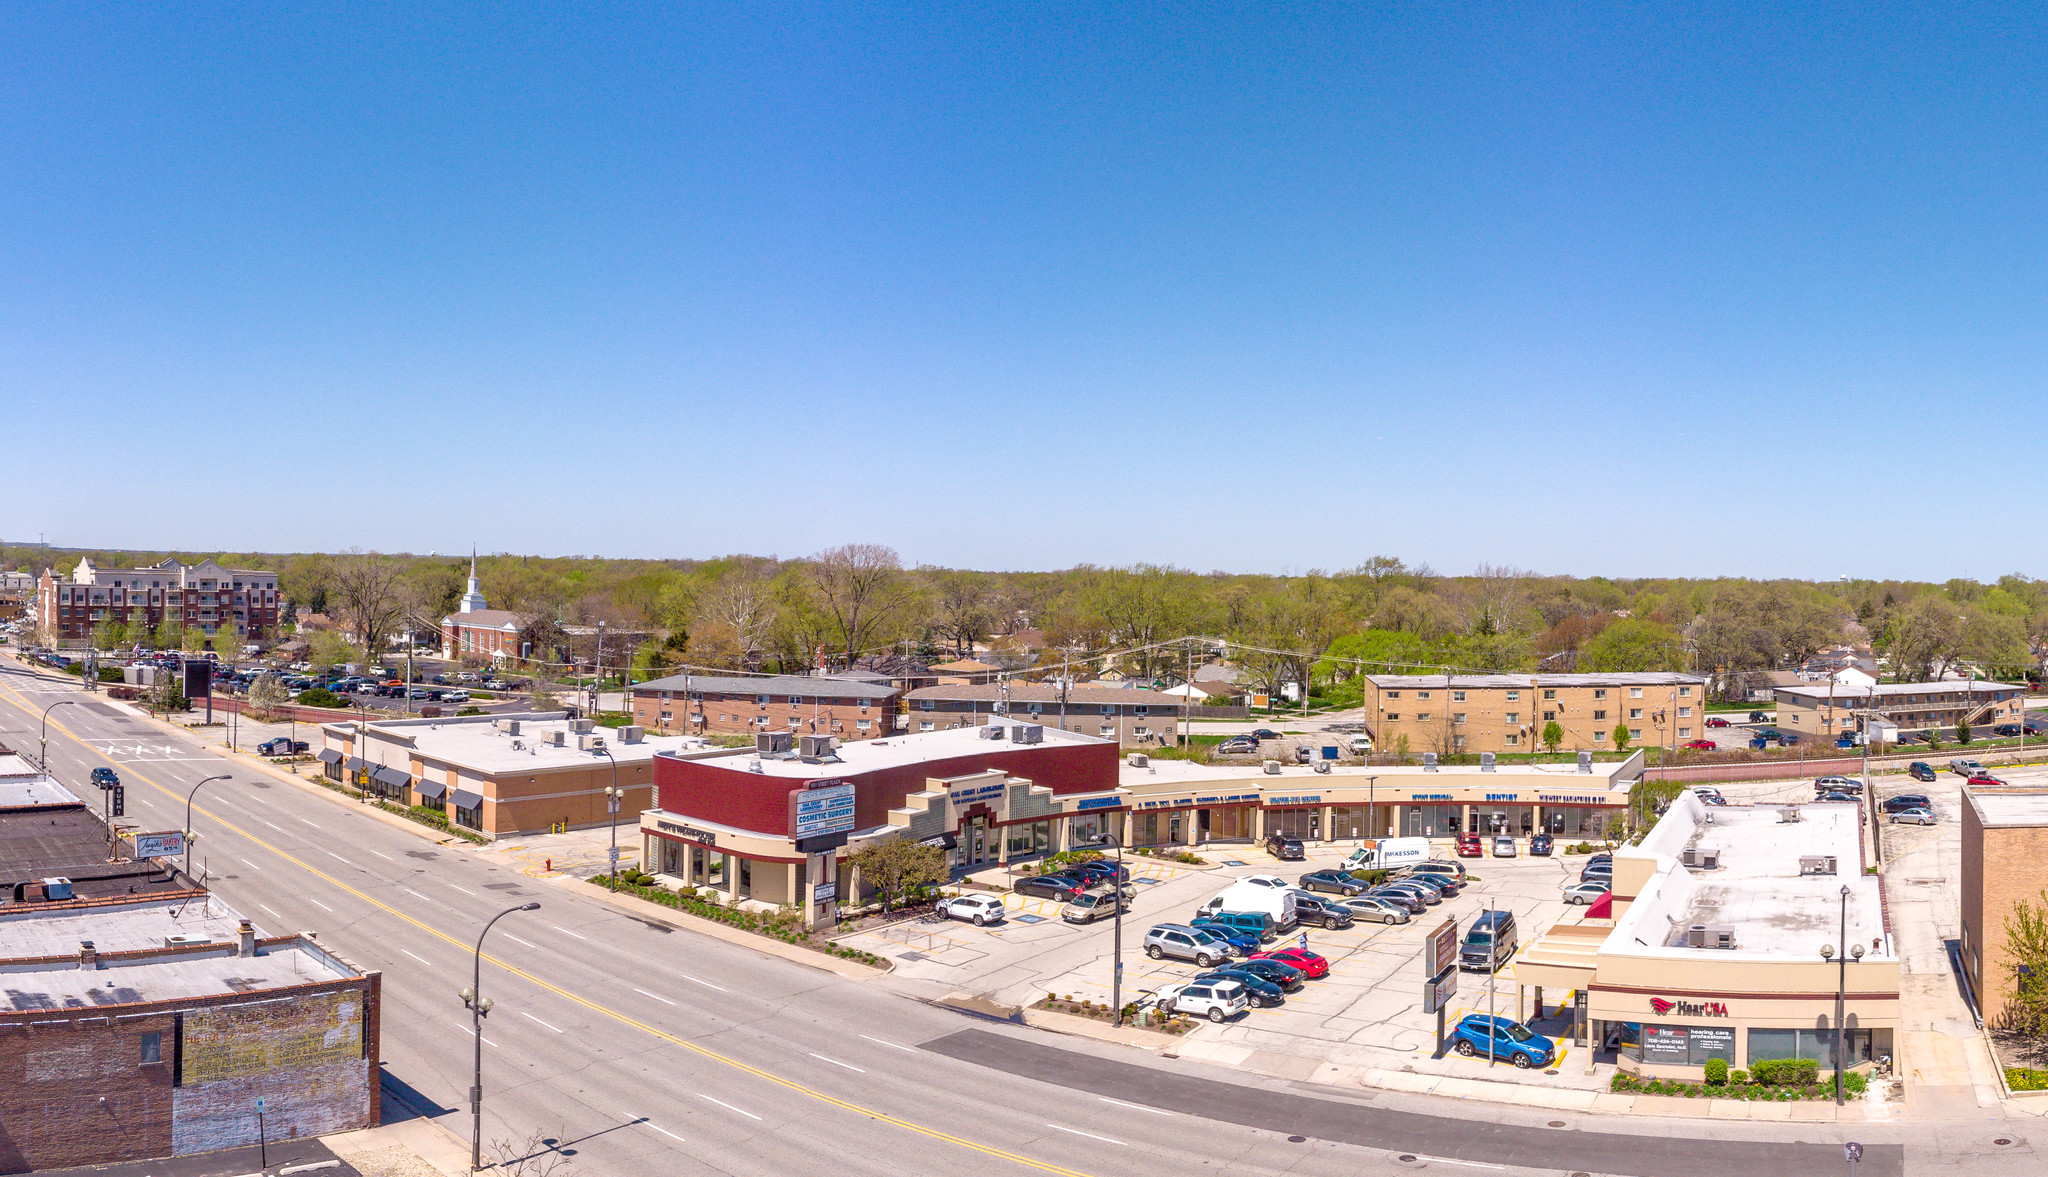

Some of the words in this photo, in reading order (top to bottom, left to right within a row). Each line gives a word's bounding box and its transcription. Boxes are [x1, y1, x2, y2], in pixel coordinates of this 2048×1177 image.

[799, 812, 827, 823] COSMETIC
[828, 807, 853, 818] SURGERY
[162, 838, 180, 846] BAKERY
[1677, 1001, 1728, 1015] HearUSA
